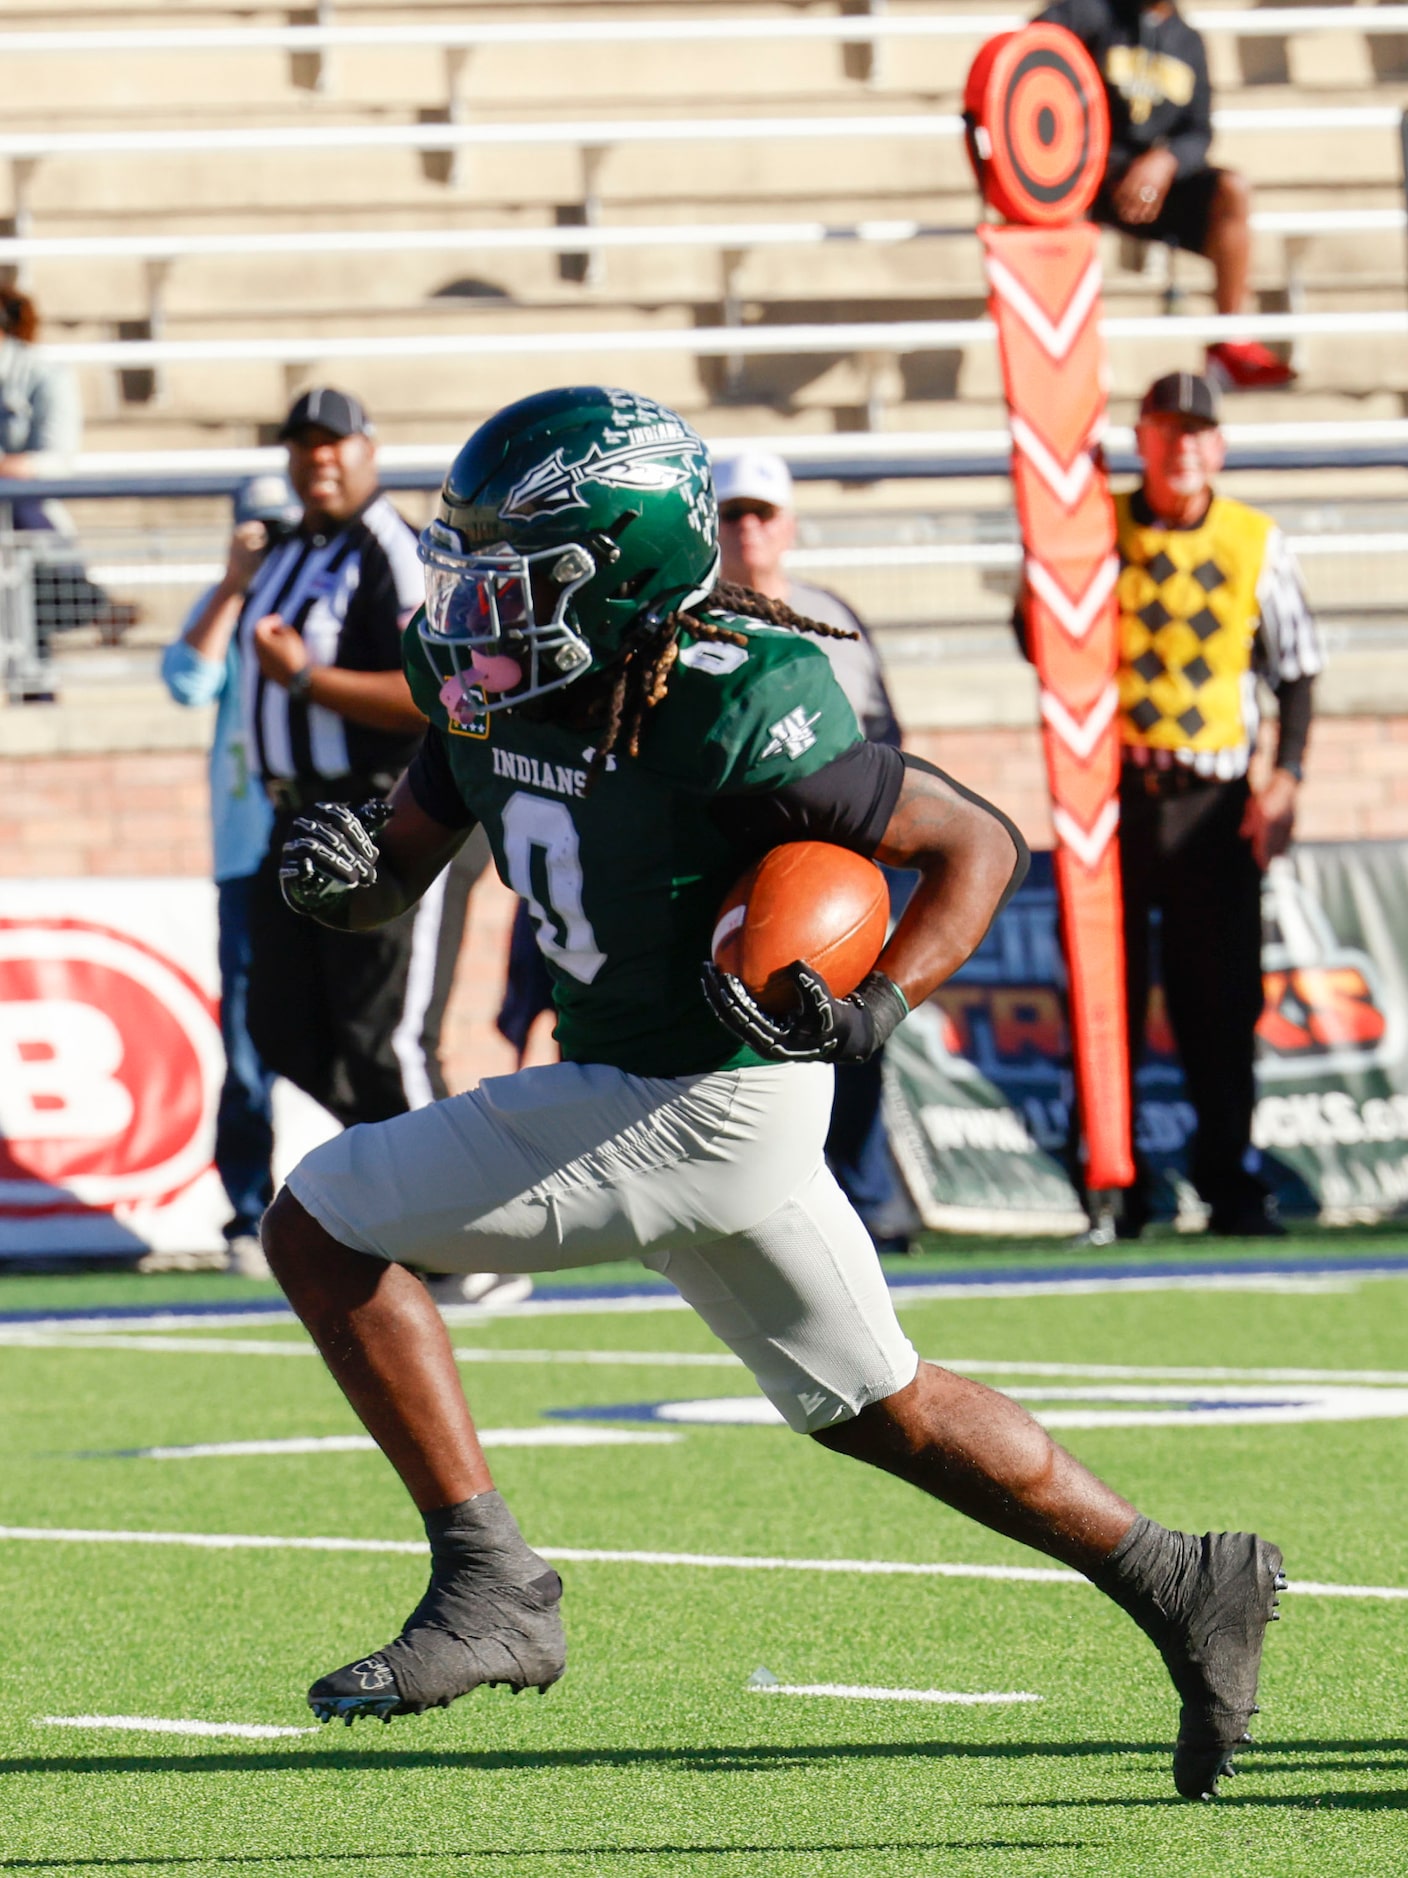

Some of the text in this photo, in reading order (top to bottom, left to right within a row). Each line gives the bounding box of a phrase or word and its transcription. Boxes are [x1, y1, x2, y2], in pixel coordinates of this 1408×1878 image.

[626, 421, 686, 446] INDIANS
[491, 747, 588, 799] INDIANS
[501, 790, 608, 985] 0
